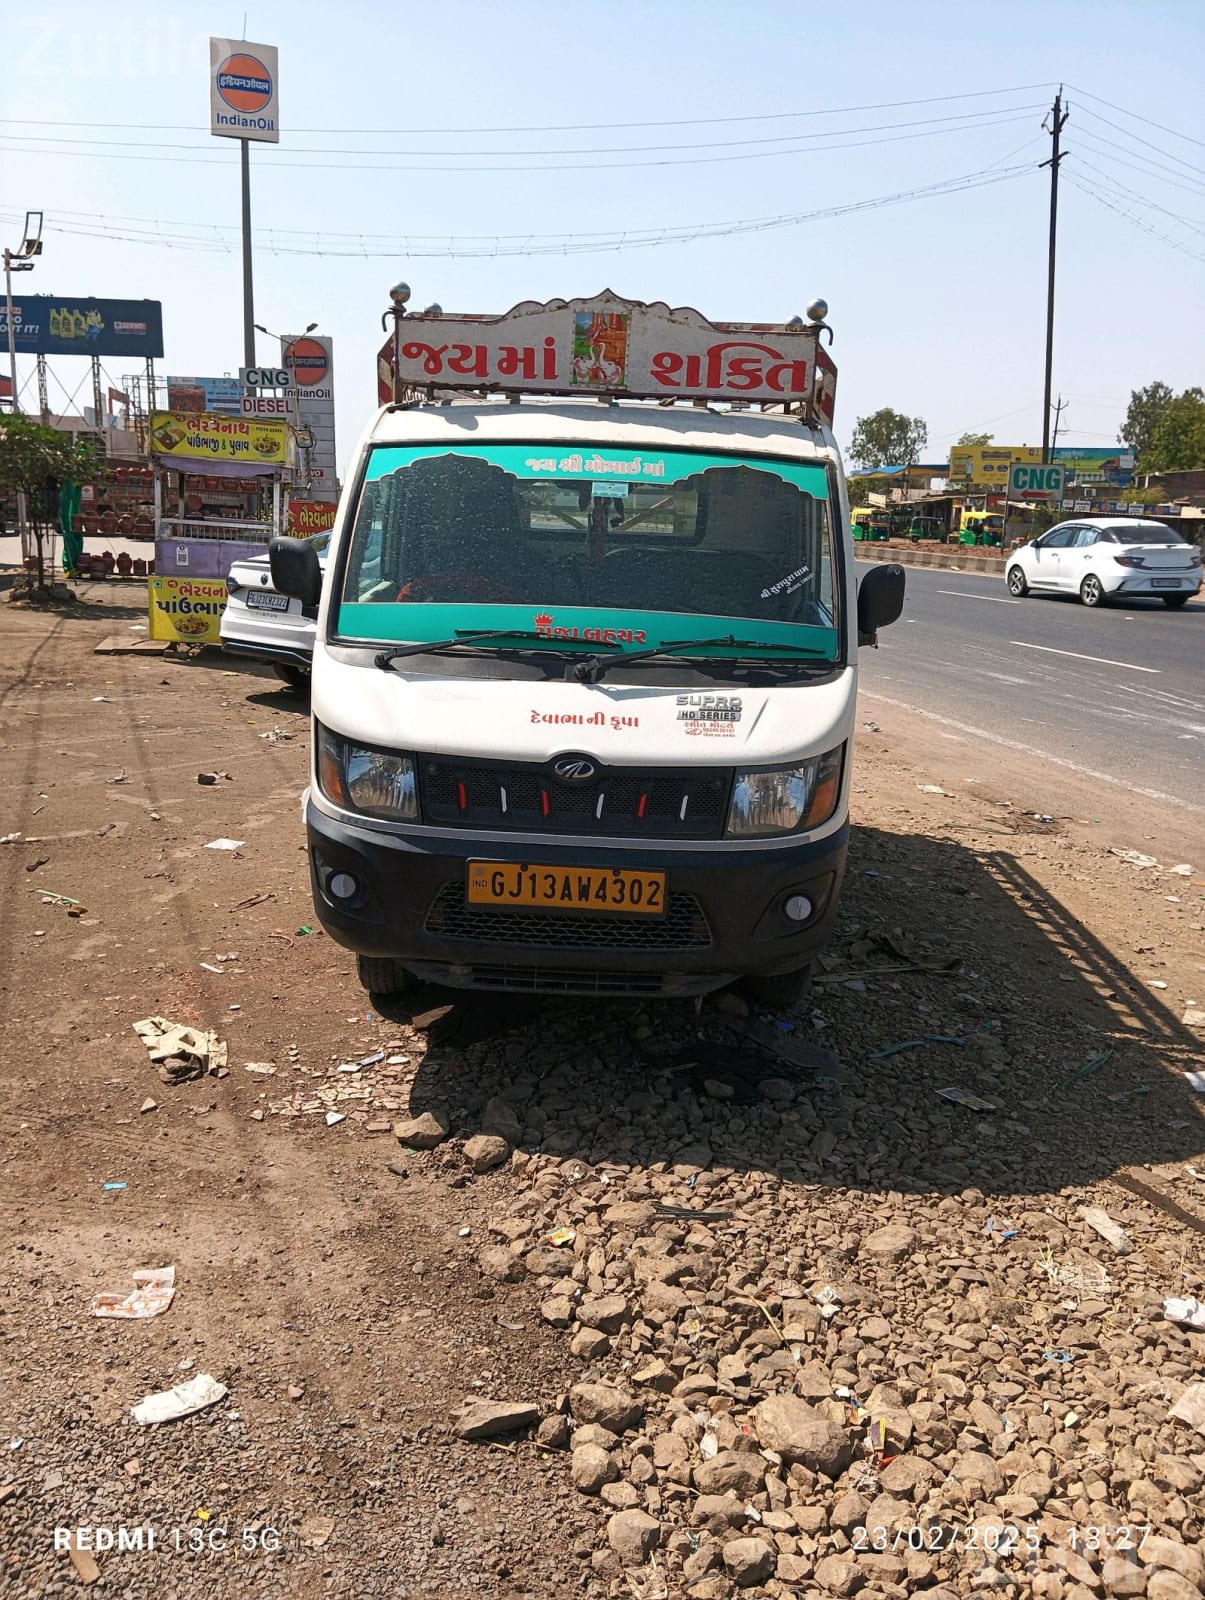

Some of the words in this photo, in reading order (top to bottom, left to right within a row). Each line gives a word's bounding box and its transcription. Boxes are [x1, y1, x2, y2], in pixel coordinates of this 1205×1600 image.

[216, 112, 275, 132] IndianOil
[401, 341, 490, 377] જય
[496, 336, 560, 381] માં
[246, 369, 290, 386] CNG
[243, 399, 294, 414] DIESEL
[221, 438, 227, 450] &
[1013, 467, 1062, 491] CNG
[676, 695, 743, 708] SUPRO
[586, 711, 605, 726] ની
[681, 711, 696, 720] HD
[700, 711, 736, 721] SERIES
[472, 879, 488, 889] IND
[491, 871, 661, 906] GJ13AW4302
